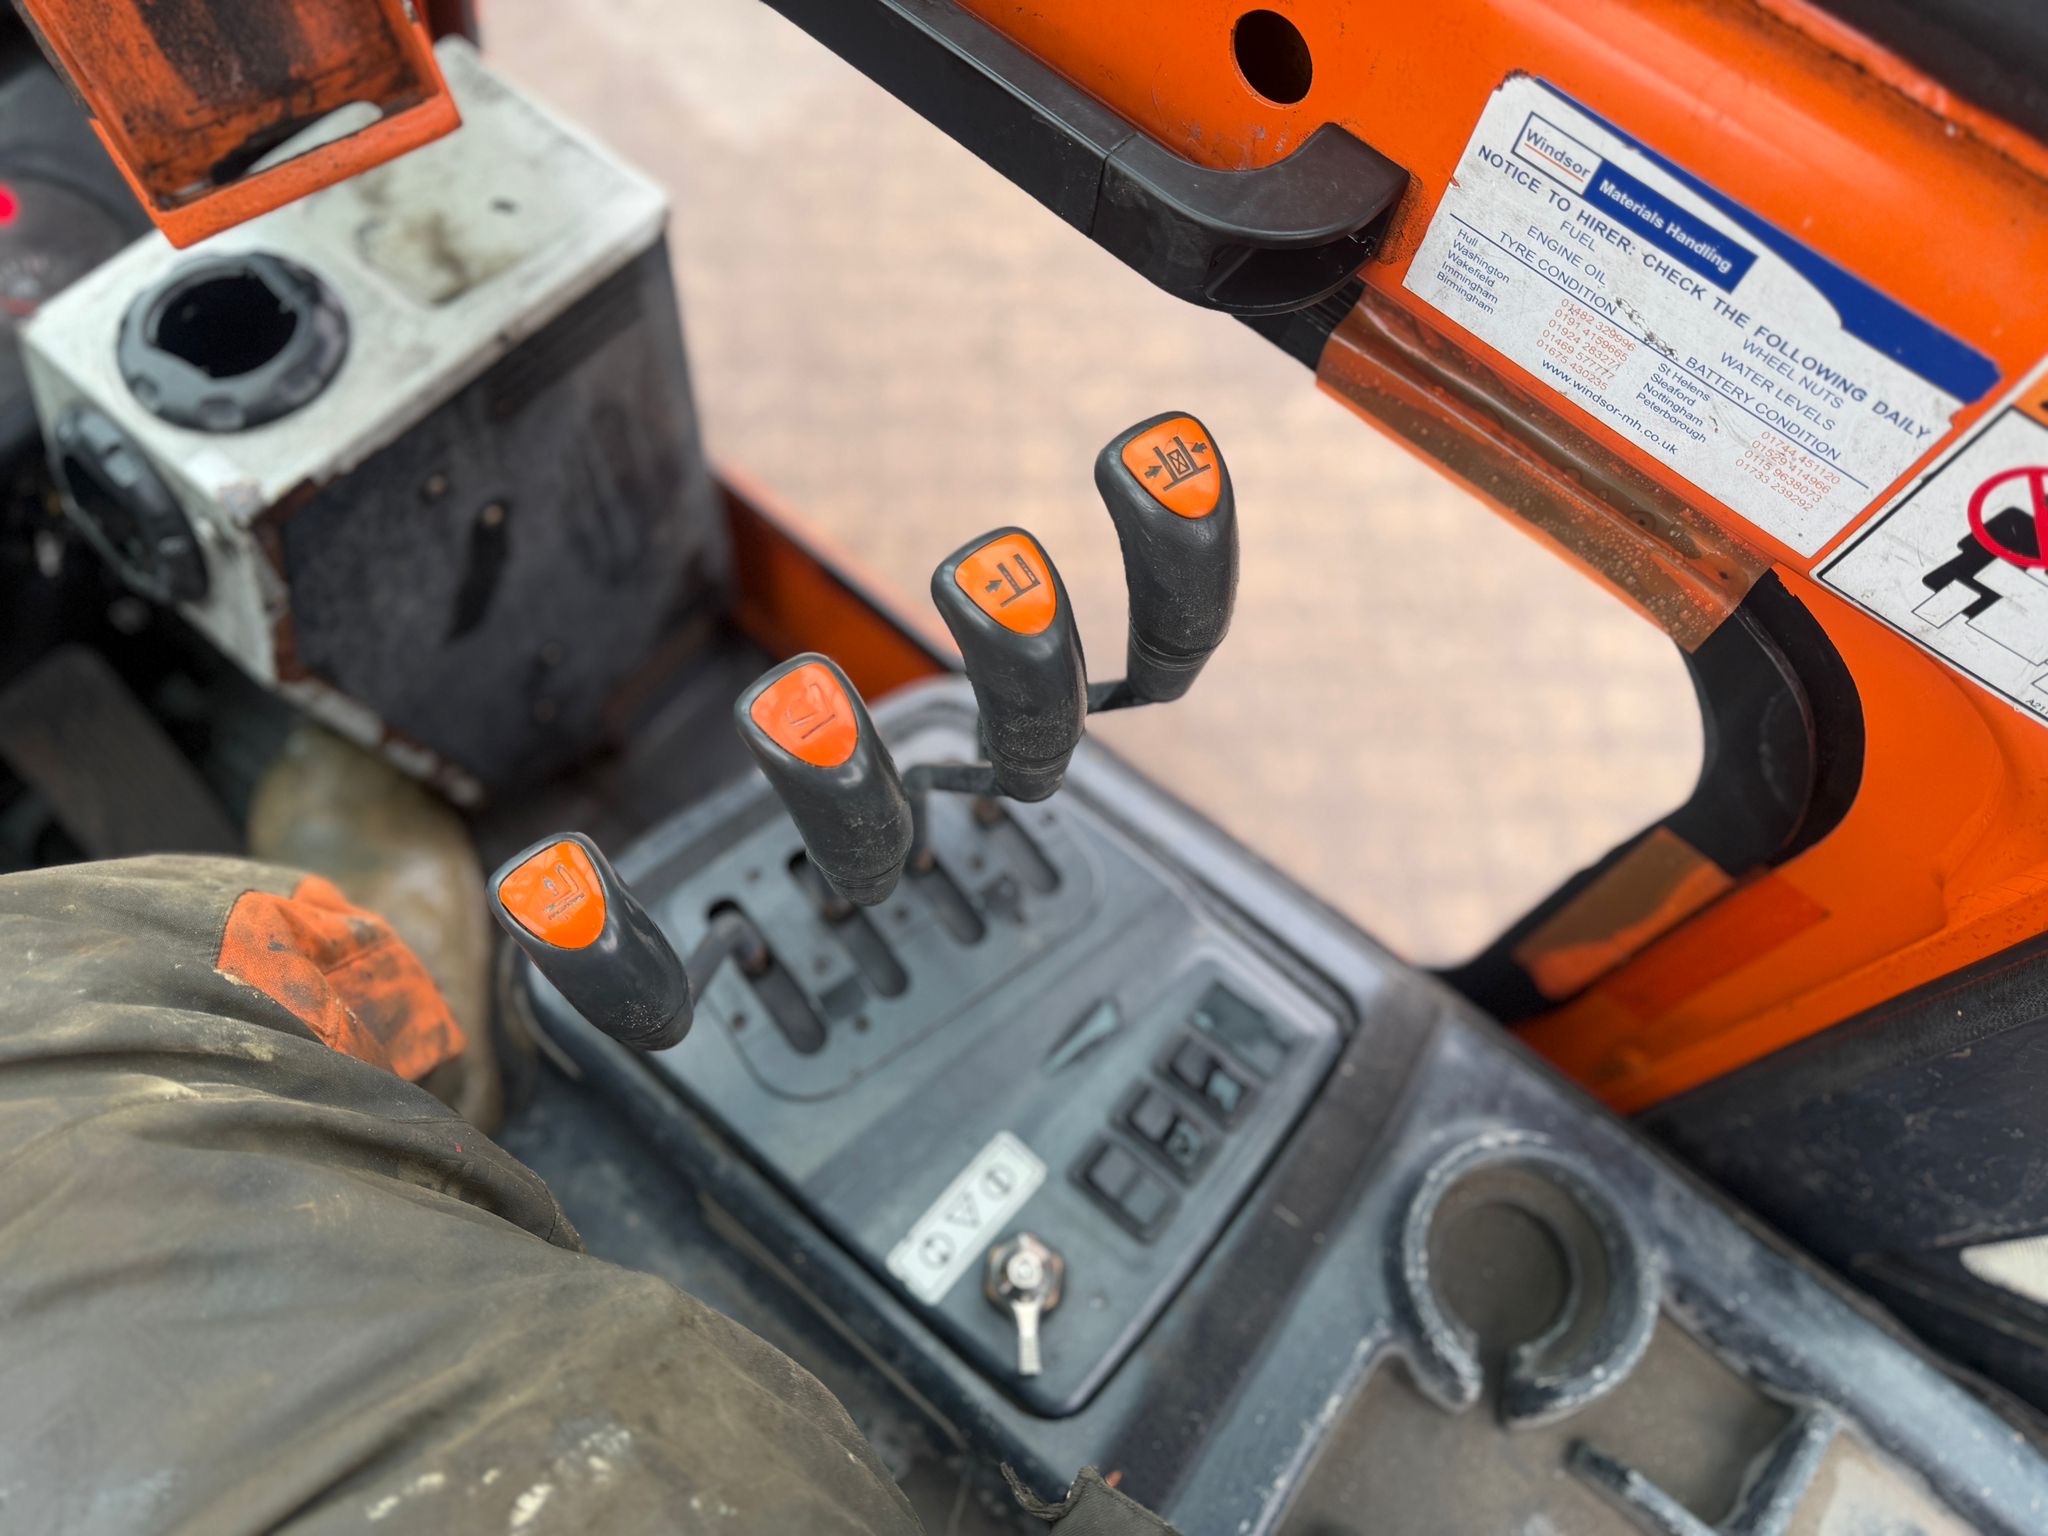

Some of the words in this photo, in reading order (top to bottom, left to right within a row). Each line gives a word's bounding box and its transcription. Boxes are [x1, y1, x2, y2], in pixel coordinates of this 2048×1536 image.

[1525, 128, 1591, 177] Windsor
[1457, 228, 1478, 247] Hull
[1560, 220, 1595, 252] FUEL
[1599, 179, 1665, 229] Materials
[1665, 221, 1733, 274] Handling
[1448, 249, 1496, 288] Wakefield
[1453, 239, 1510, 284] Washington
[1500, 231, 1537, 263] TYRE
[1538, 259, 1617, 316] CONDITION
[1527, 225, 1583, 268] ENGINE
[1585, 263, 1607, 285] OIL
[1436, 271, 1494, 315] Birmingham
[1441, 261, 1498, 304] Immingham
[1478, 144, 1542, 193] NOTICE
[1546, 189, 1571, 212] TO
[1576, 209, 1636, 256] HIRER:
[1642, 253, 1707, 301] CHECK
[1713, 296, 1750, 329] THE
[1753, 325, 1868, 402] FOLLOWING
[1872, 401, 1931, 440] DAILY
[1548, 319, 1581, 344] 01924
[1554, 309, 1581, 330] 0191
[1583, 328, 1628, 362] 4159665
[1561, 298, 1594, 324] 01482
[1596, 321, 1636, 351] 329996
[1536, 339, 1567, 364] 01675
[1570, 361, 1608, 390] 430235
[1542, 329, 1574, 354] 01469
[1576, 351, 1616, 380] 577777
[1742, 338, 1797, 381] WHEEL
[1799, 376, 1844, 409] NUTS
[1542, 359, 1679, 454] www.windsor-mh.co.uk
[1642, 382, 1703, 427] Nottingham
[1650, 373, 1696, 407] Sleaford
[1658, 363, 1670, 374] St
[1672, 372, 1711, 402] Helens
[1685, 356, 1756, 404] BATTERY
[1755, 402, 1841, 461] CONDITION
[1720, 351, 1775, 393] WATER
[1775, 388, 1836, 431] LEVELS
[1635, 391, 1706, 443] Peterborough
[1744, 450, 1771, 471] 0115
[1773, 468, 1823, 503] 9638073
[1752, 440, 1787, 466] 01529
[1789, 461, 1831, 494] 414966
[1761, 431, 1796, 457] 01744
[1799, 455, 1840, 484] 451120
[1735, 459, 1770, 484] 01733
[1771, 483, 1814, 513] 239292
